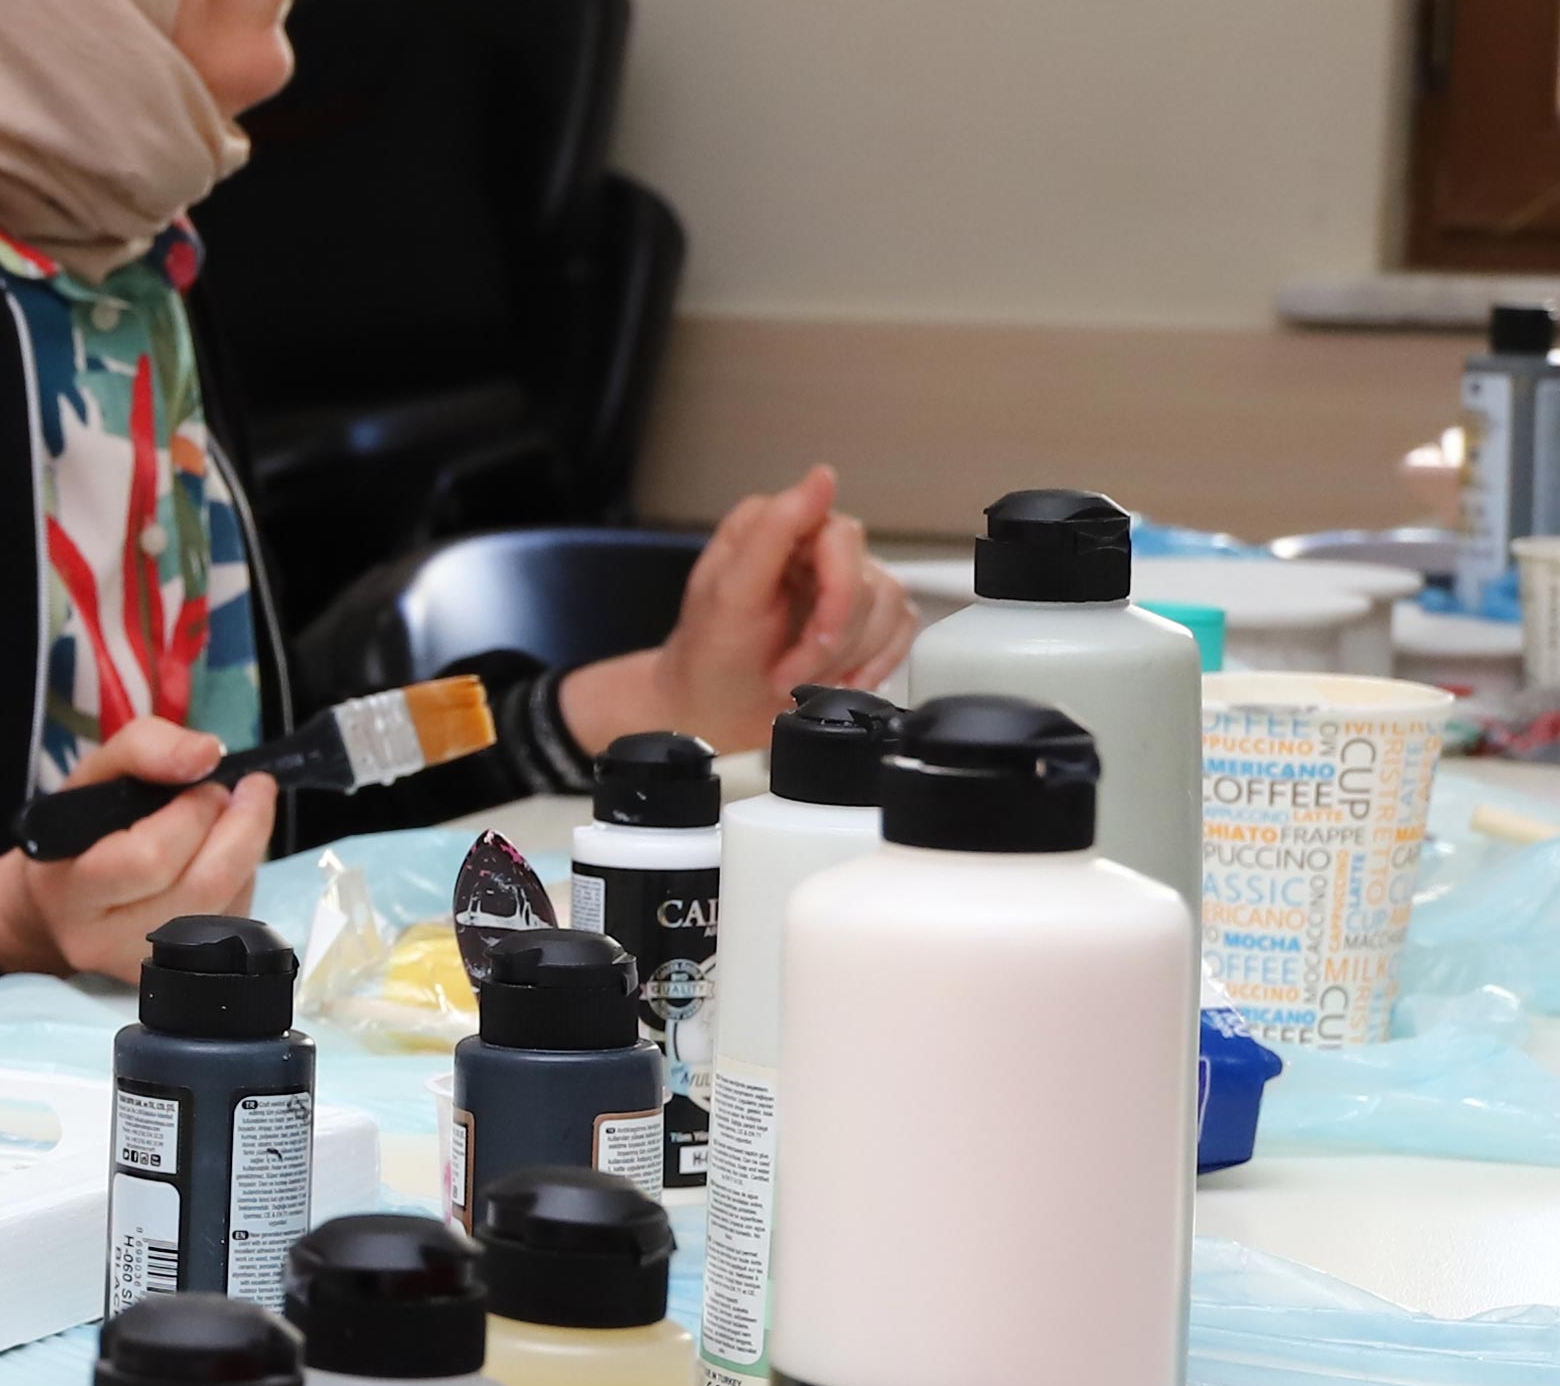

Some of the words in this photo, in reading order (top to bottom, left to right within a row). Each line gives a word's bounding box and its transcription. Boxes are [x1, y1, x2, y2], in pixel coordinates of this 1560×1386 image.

[1339, 737, 1376, 821] CUP
[1281, 826, 1365, 846] FRAPPE
[1224, 933, 1301, 952] MOCHA
[651, 983, 706, 996] QUALITY
[1318, 985, 1348, 1050] CU
[122, 1234, 135, 1283] H-060
